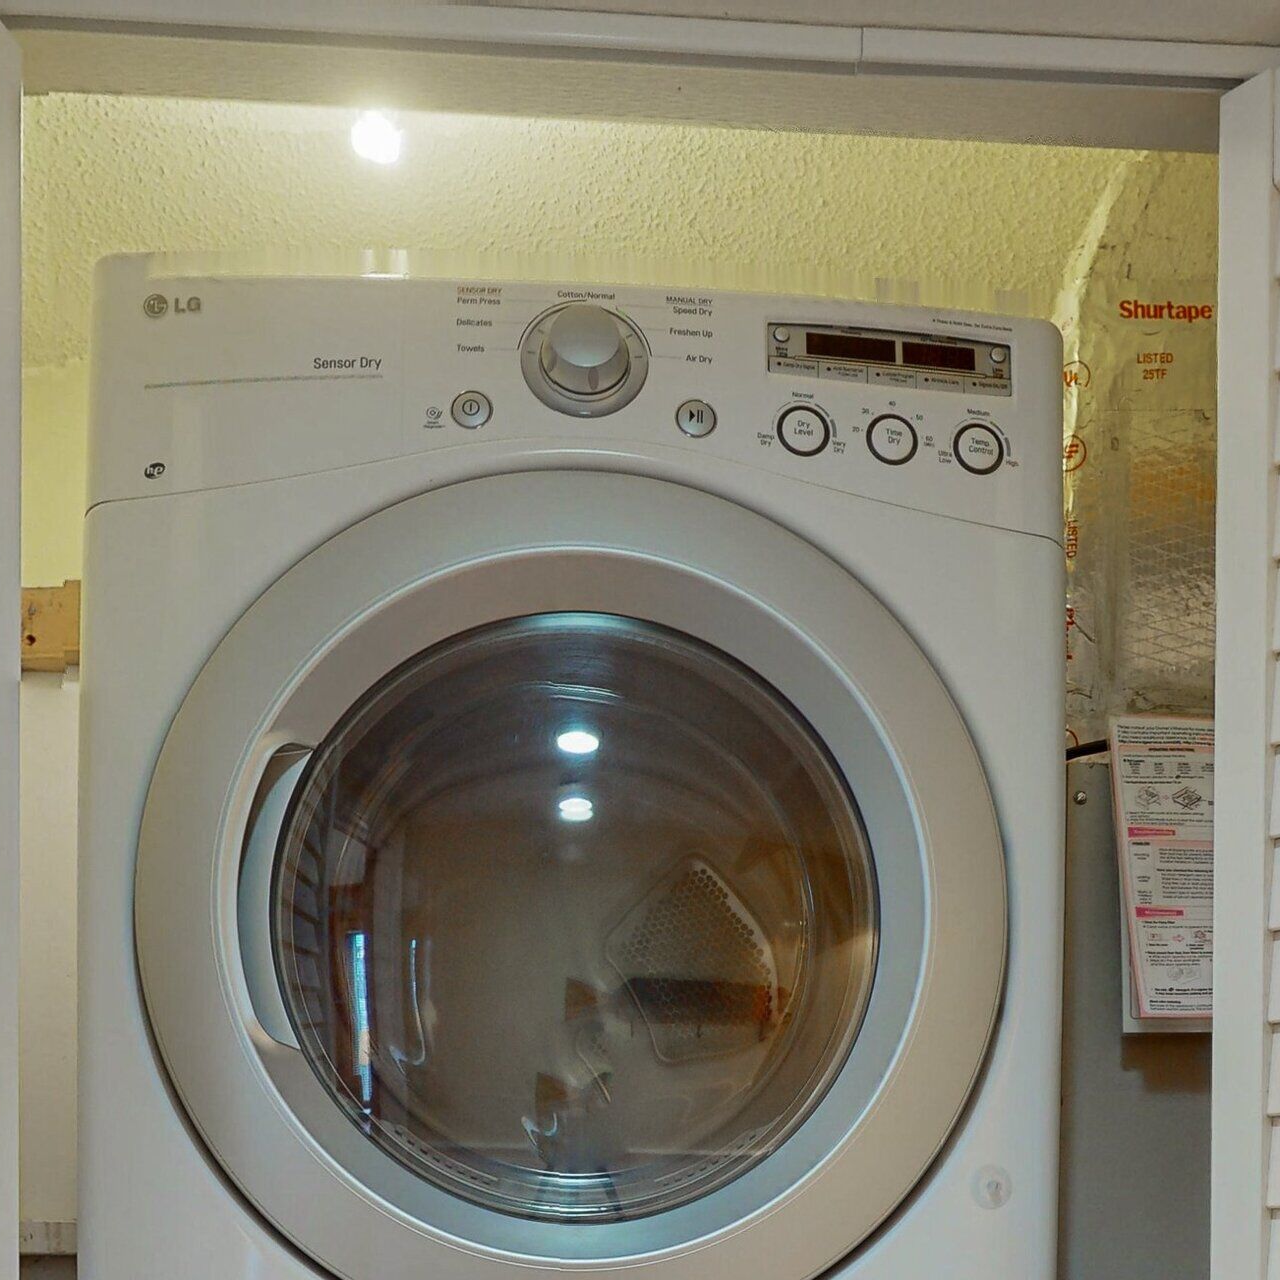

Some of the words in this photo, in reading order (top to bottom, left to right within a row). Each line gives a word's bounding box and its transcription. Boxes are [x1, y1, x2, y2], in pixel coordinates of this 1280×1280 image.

[557, 290, 616, 300] Cotton/Normal
[174, 296, 202, 314] LG
[456, 297, 478, 305] Perm
[479, 297, 501, 306] Press
[673, 306, 698, 316] Speed
[698, 308, 713, 317] Dry
[1119, 300, 1213, 323] Shurtape
[456, 318, 493, 327] Delicates
[669, 327, 702, 337] Freshen
[702, 329, 713, 338] Up
[456, 344, 485, 353] Towels
[313, 357, 357, 370] Sensor
[359, 356, 382, 371] Dry
[685, 354, 697, 362] Air
[698, 355, 713, 364] Dry
[1136, 352, 1174, 365] LISTED
[967, 408, 991, 417] Medium
[797, 420, 810, 429] Dry
[794, 428, 814, 437] Level
[886, 428, 903, 437] Time
[887, 436, 901, 446] Dry
[971, 437, 990, 448] Temp
[968, 446, 994, 457] Control
